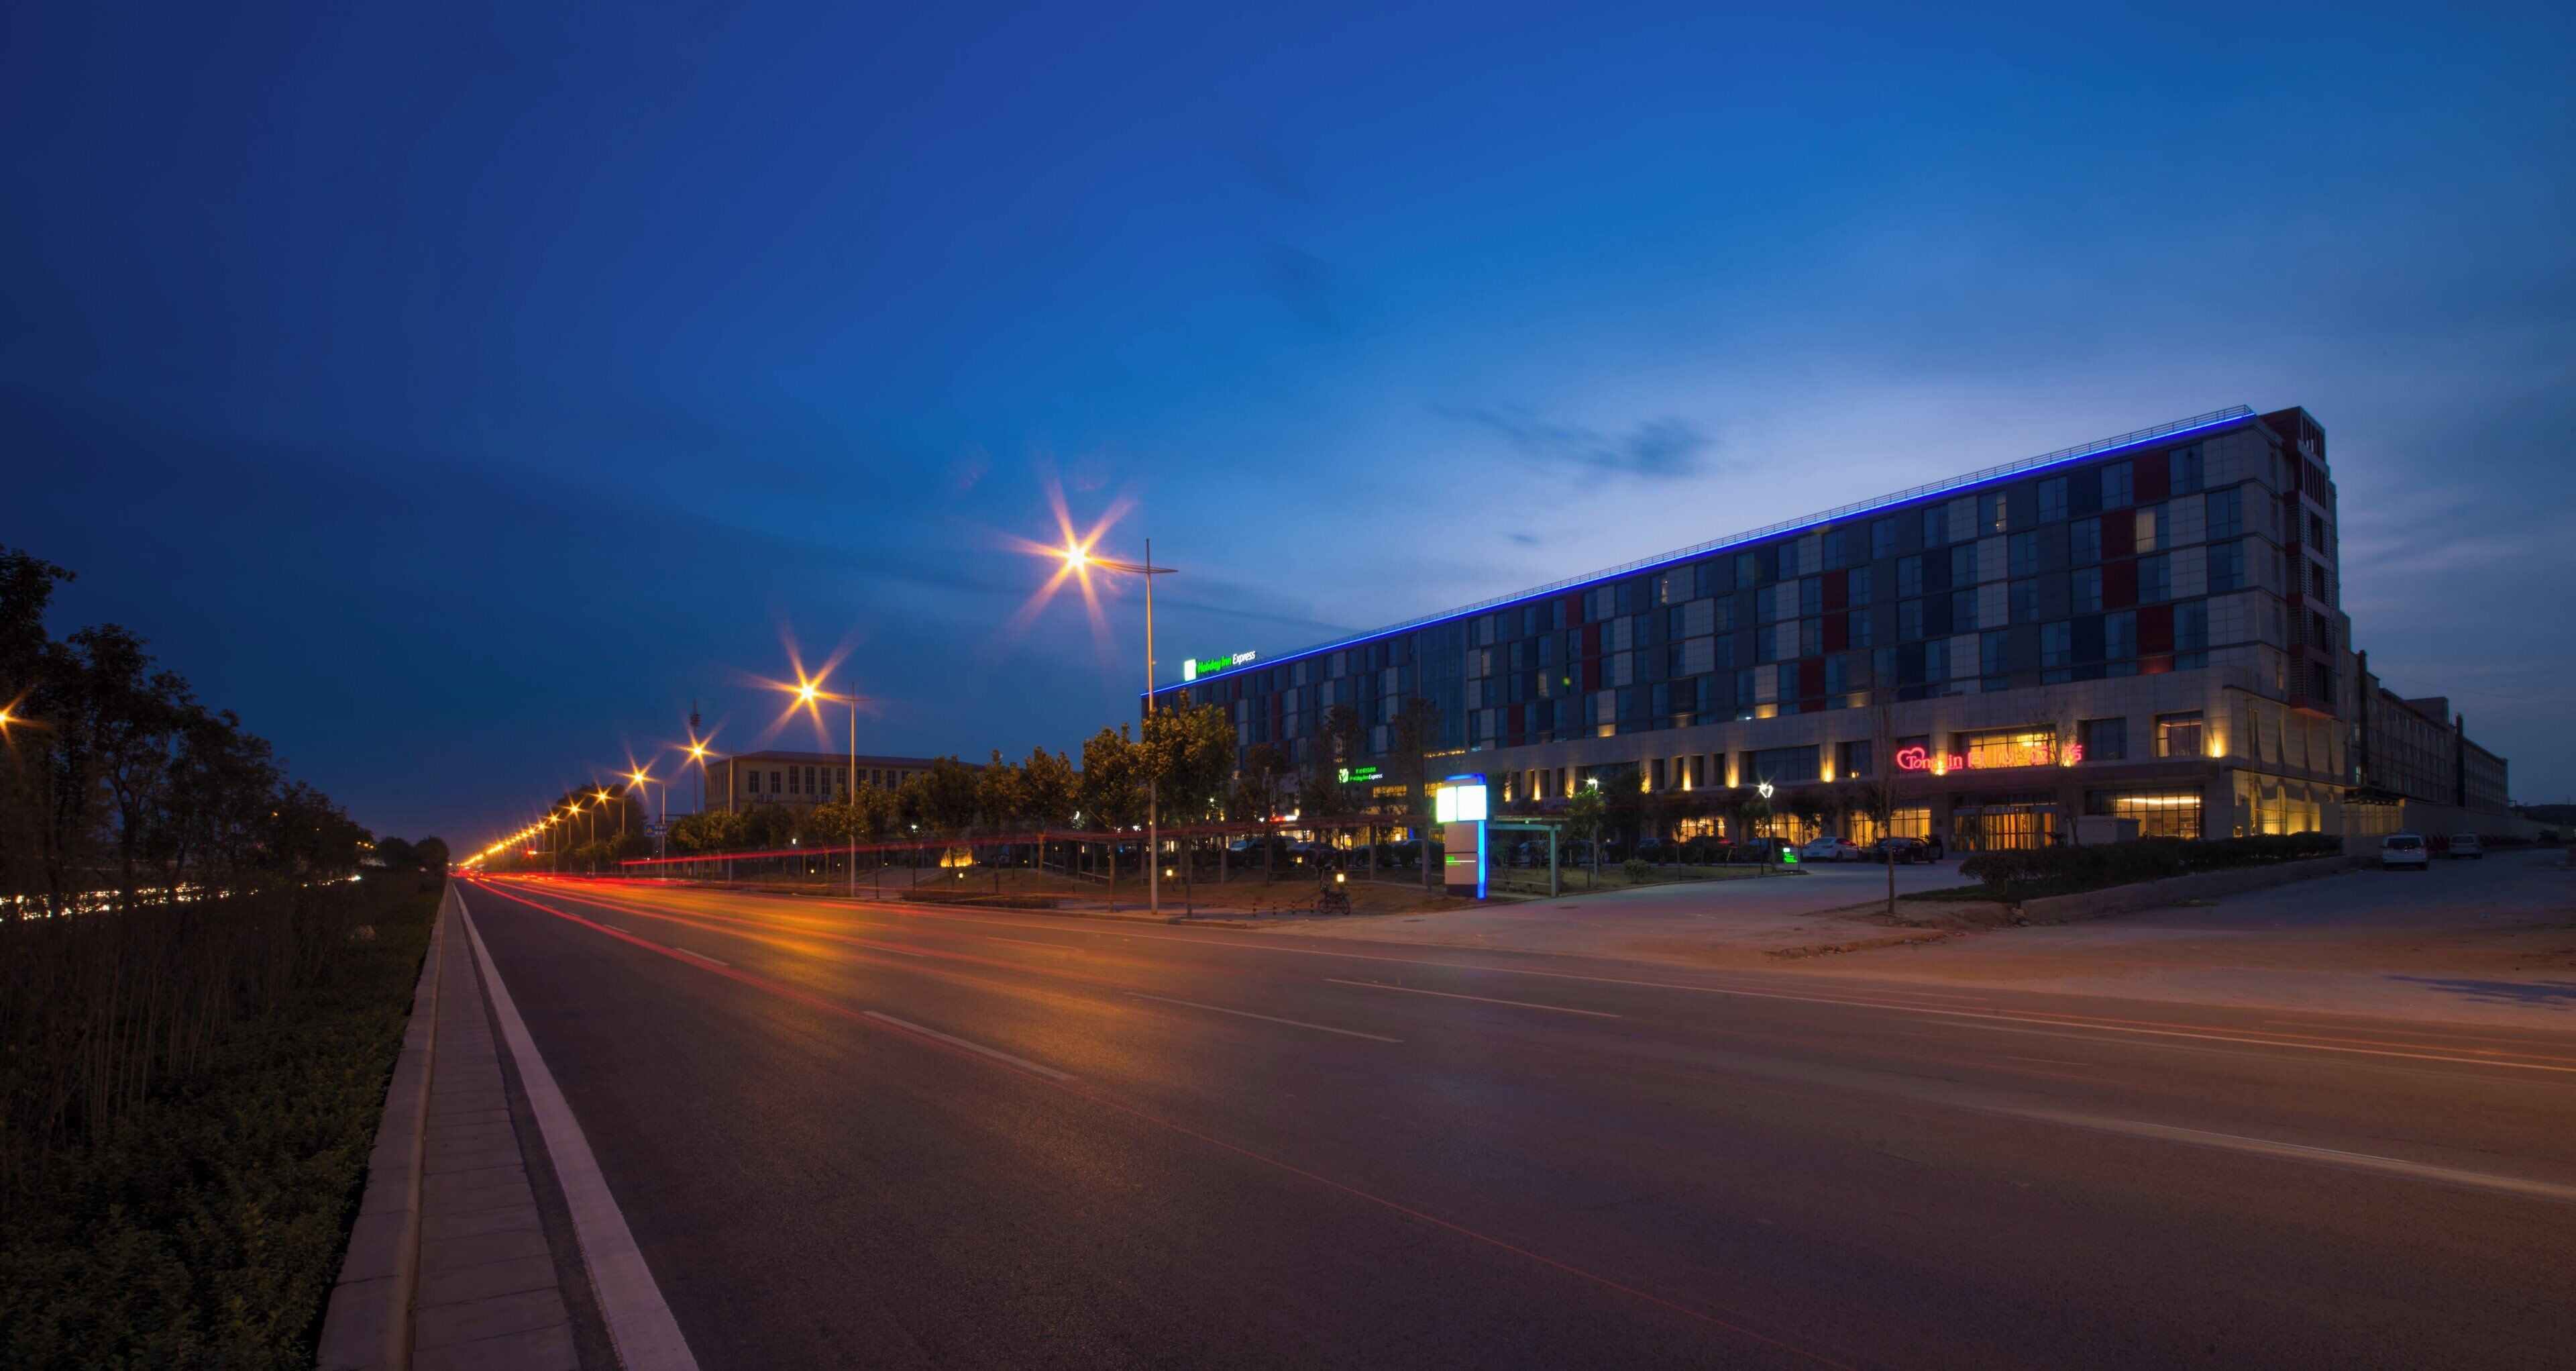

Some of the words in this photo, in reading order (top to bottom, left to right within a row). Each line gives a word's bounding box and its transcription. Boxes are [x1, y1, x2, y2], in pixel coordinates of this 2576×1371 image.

[1197, 659, 1221, 673] Holiday
[1222, 656, 1232, 667] Inn
[1232, 651, 1255, 665] Express
